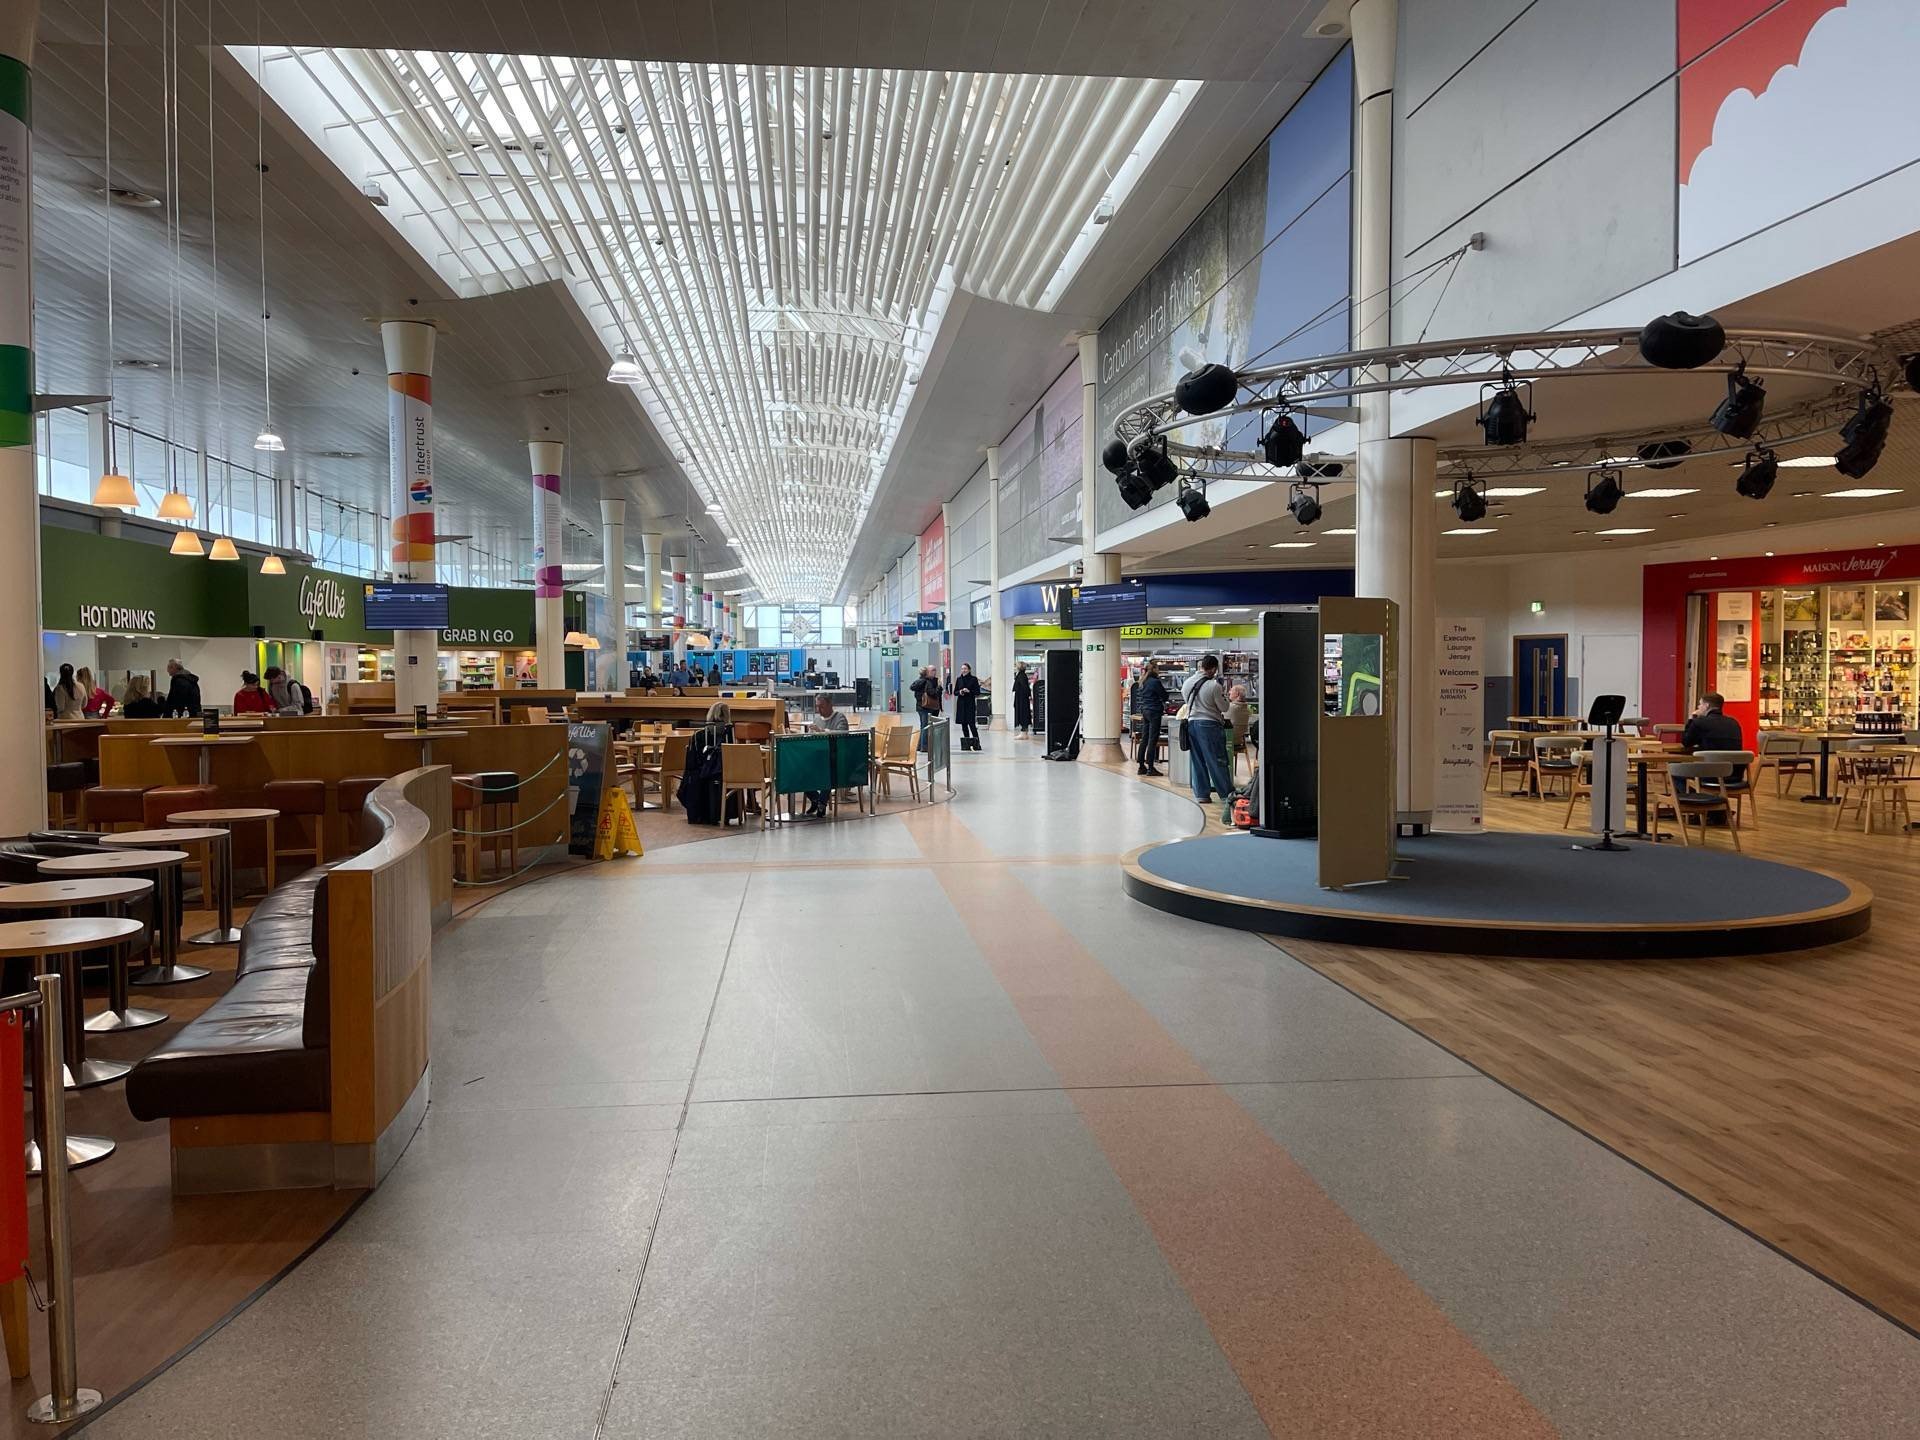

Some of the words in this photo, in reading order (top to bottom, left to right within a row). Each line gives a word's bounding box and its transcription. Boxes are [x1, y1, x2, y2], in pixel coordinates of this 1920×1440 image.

[1102, 338, 1131, 384] Carbon
[1133, 290, 1167, 356] neutral
[1169, 268, 1201, 320] flying
[414, 416, 425, 475] intertrust
[1802, 562, 1841, 574] MAISON
[1842, 555, 1885, 577] Jersey
[300, 575, 325, 631] Café
[323, 579, 345, 619] Ubé
[80, 604, 109, 628] HOT
[111, 607, 156, 631] DRINKS
[442, 628, 477, 642] GRAB
[480, 629, 490, 642] N
[492, 629, 514, 642] GO
[1120, 627, 1143, 636] LED
[1146, 627, 1184, 636] DRINKS
[1443, 634, 1476, 642] Executive
[1448, 653, 1471, 661] Jersey
[1439, 668, 1479, 676] Welcomes
